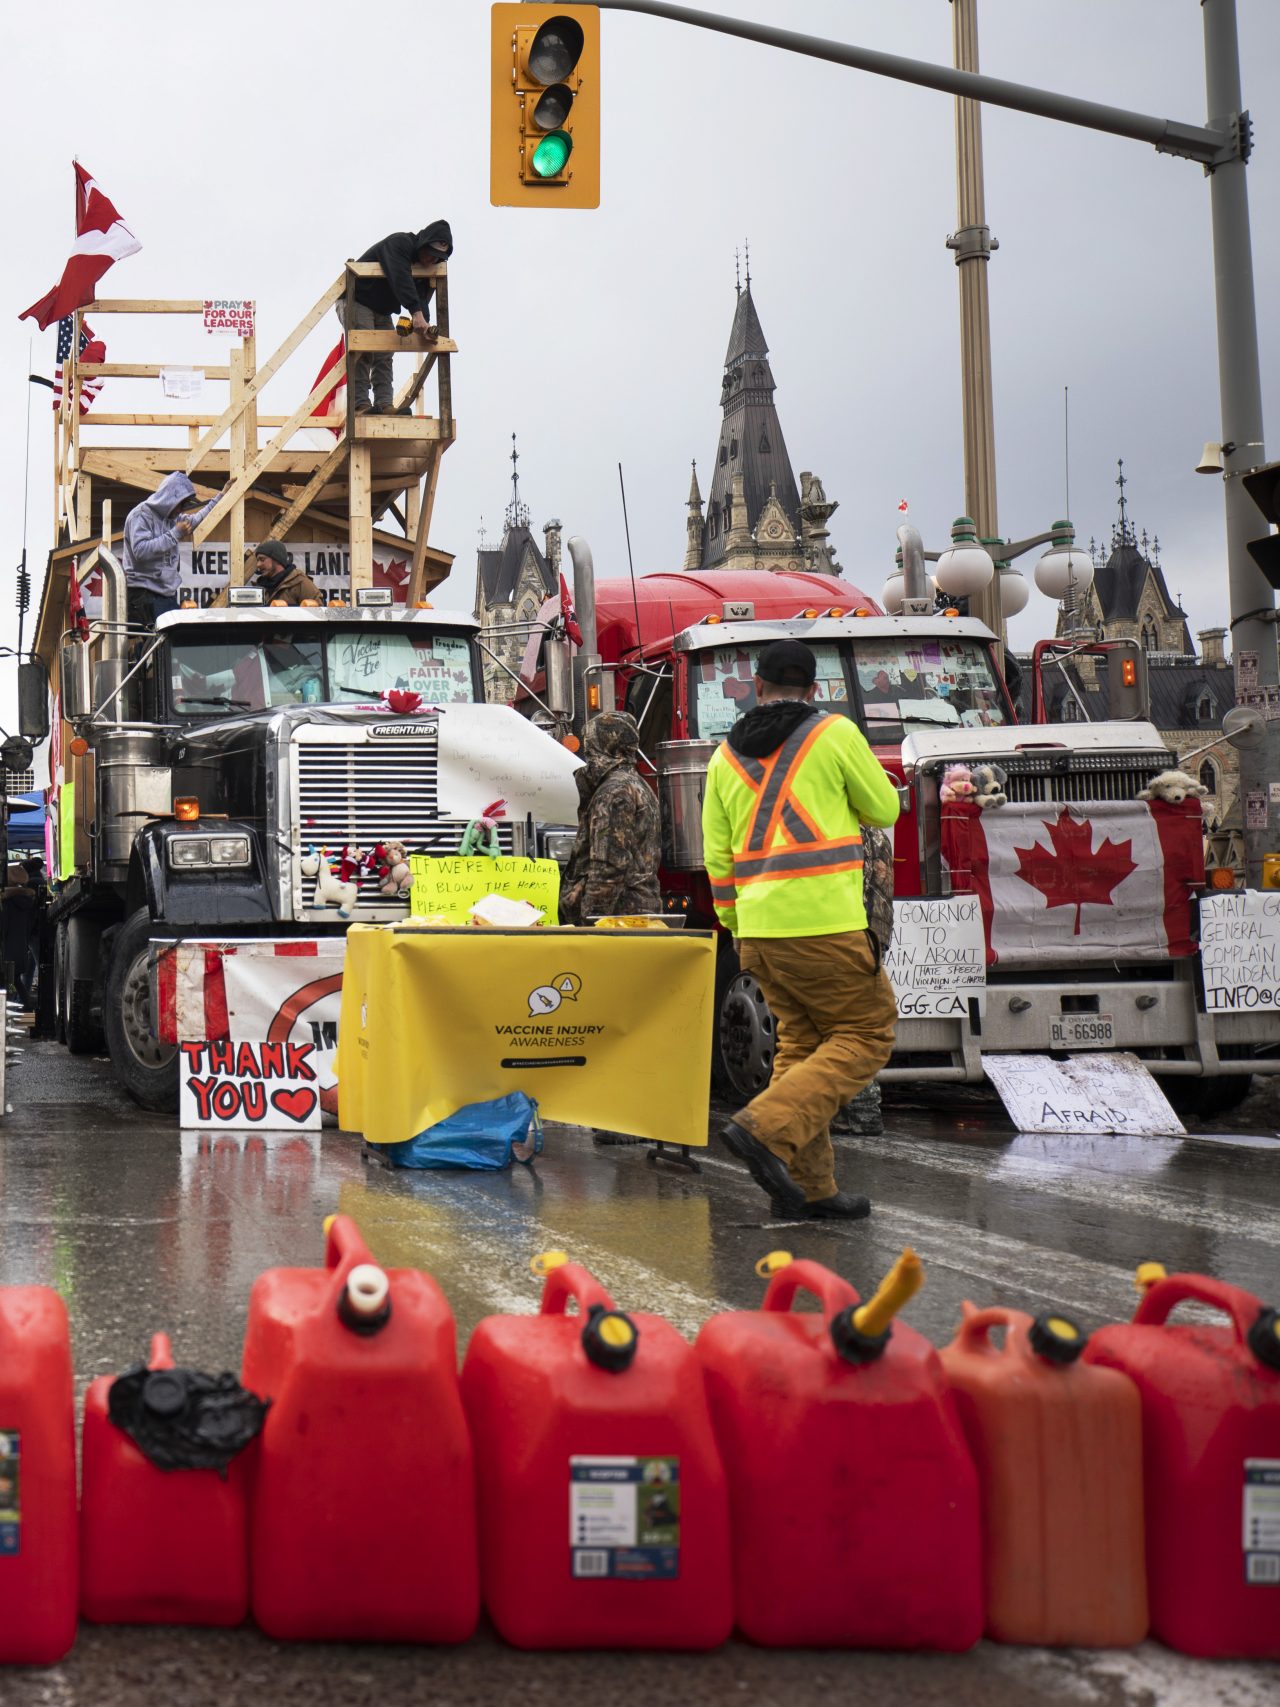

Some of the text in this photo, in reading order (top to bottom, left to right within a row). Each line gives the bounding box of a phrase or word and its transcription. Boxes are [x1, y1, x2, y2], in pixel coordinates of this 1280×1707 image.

[214, 301, 242, 309] PRAY
[205, 310, 252, 319] FOR OUR
[204, 319, 253, 328] LEADERS
[192, 551, 228, 574] KEE
[410, 668, 451, 678] FAITH
[414, 680, 450, 690] OVER
[421, 692, 449, 703] EAR
[375, 725, 435, 735] FREIGHTLINER
[412, 857, 429, 875] IF
[438, 859, 483, 874] WE'RE
[495, 861, 518, 873] NOT
[436, 881, 474, 893] BLOW
[485, 881, 510, 892] THE
[900, 901, 978, 923] GOVERNOR
[920, 926, 946, 945] TO
[1202, 922, 1274, 942] GENERAL
[924, 947, 980, 964] ABOUT
[495, 1026, 605, 1035] VACCINE INJURY
[509, 1036, 586, 1047] AWARENESS
[181, 1041, 317, 1081] THANK
[186, 1076, 267, 1121] YOU
